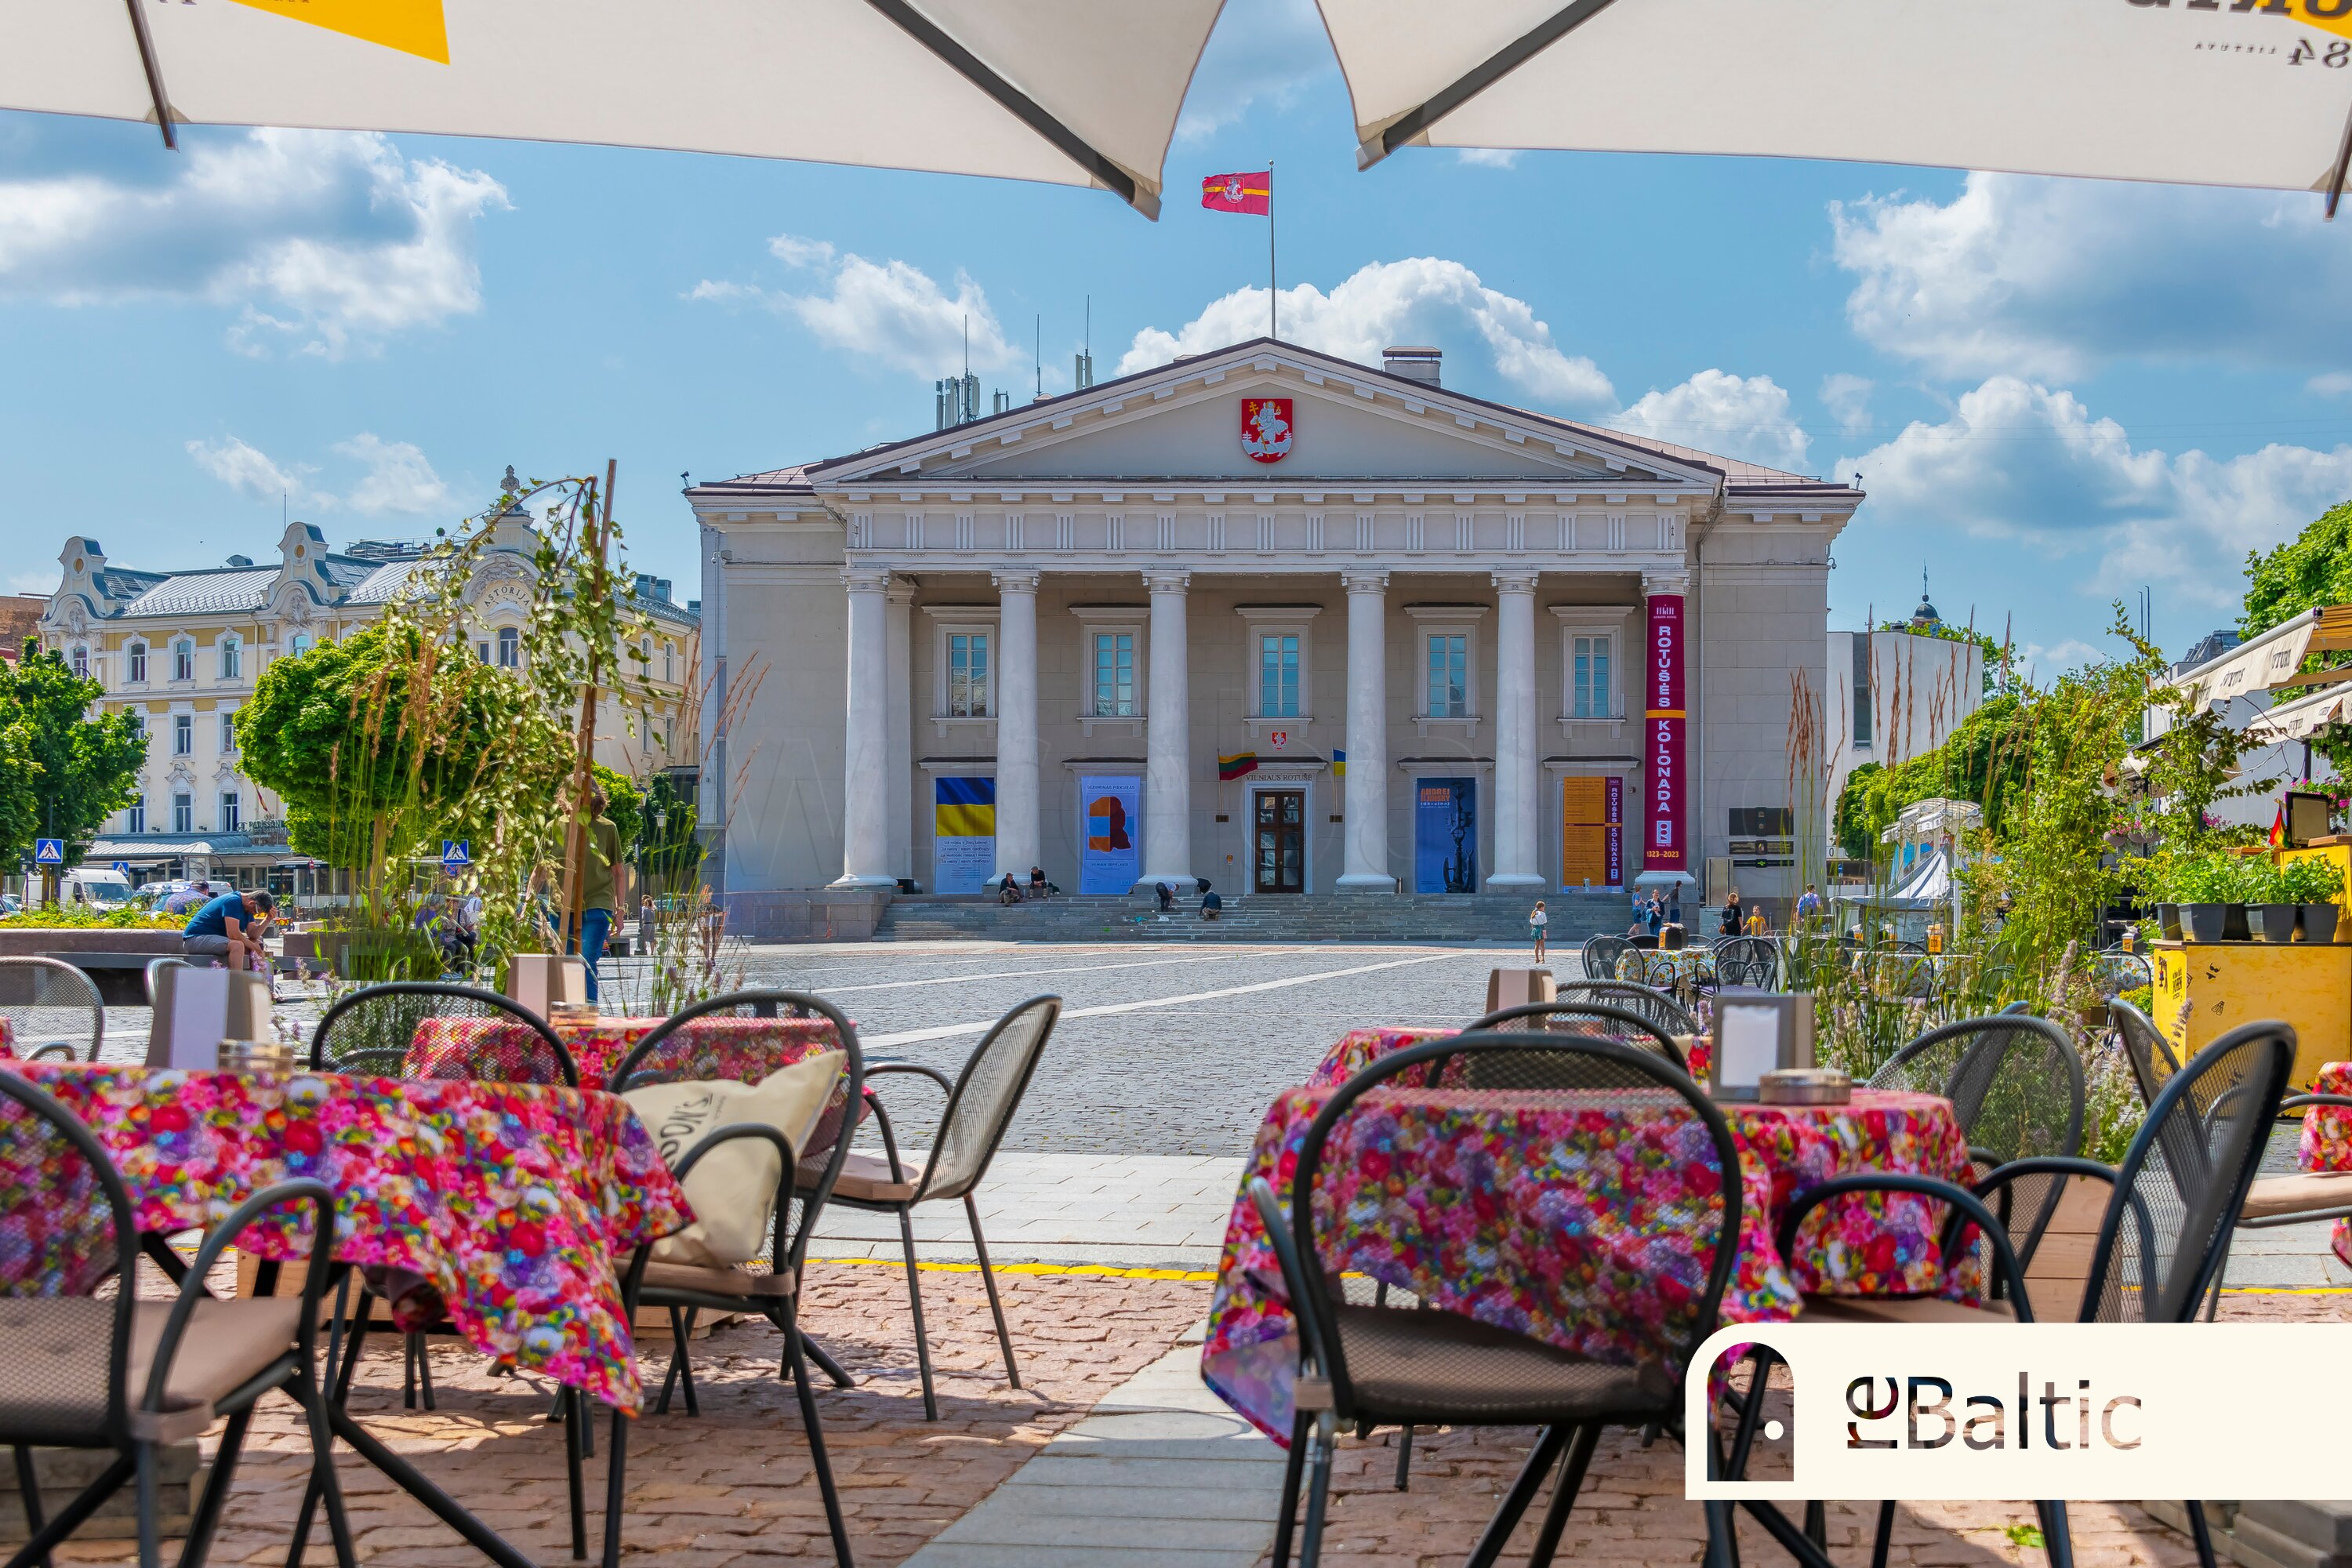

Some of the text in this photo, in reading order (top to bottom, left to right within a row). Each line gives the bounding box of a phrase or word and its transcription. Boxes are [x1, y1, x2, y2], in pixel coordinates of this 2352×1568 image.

[484, 586, 530, 608] ASTORIJA
[1657, 625, 1671, 708] ROTUŠĖS
[1283, 772, 1313, 781] ROTUŠĖ
[1657, 720, 1671, 812] KOLONADA
[659, 1097, 710, 1168] DON'S
